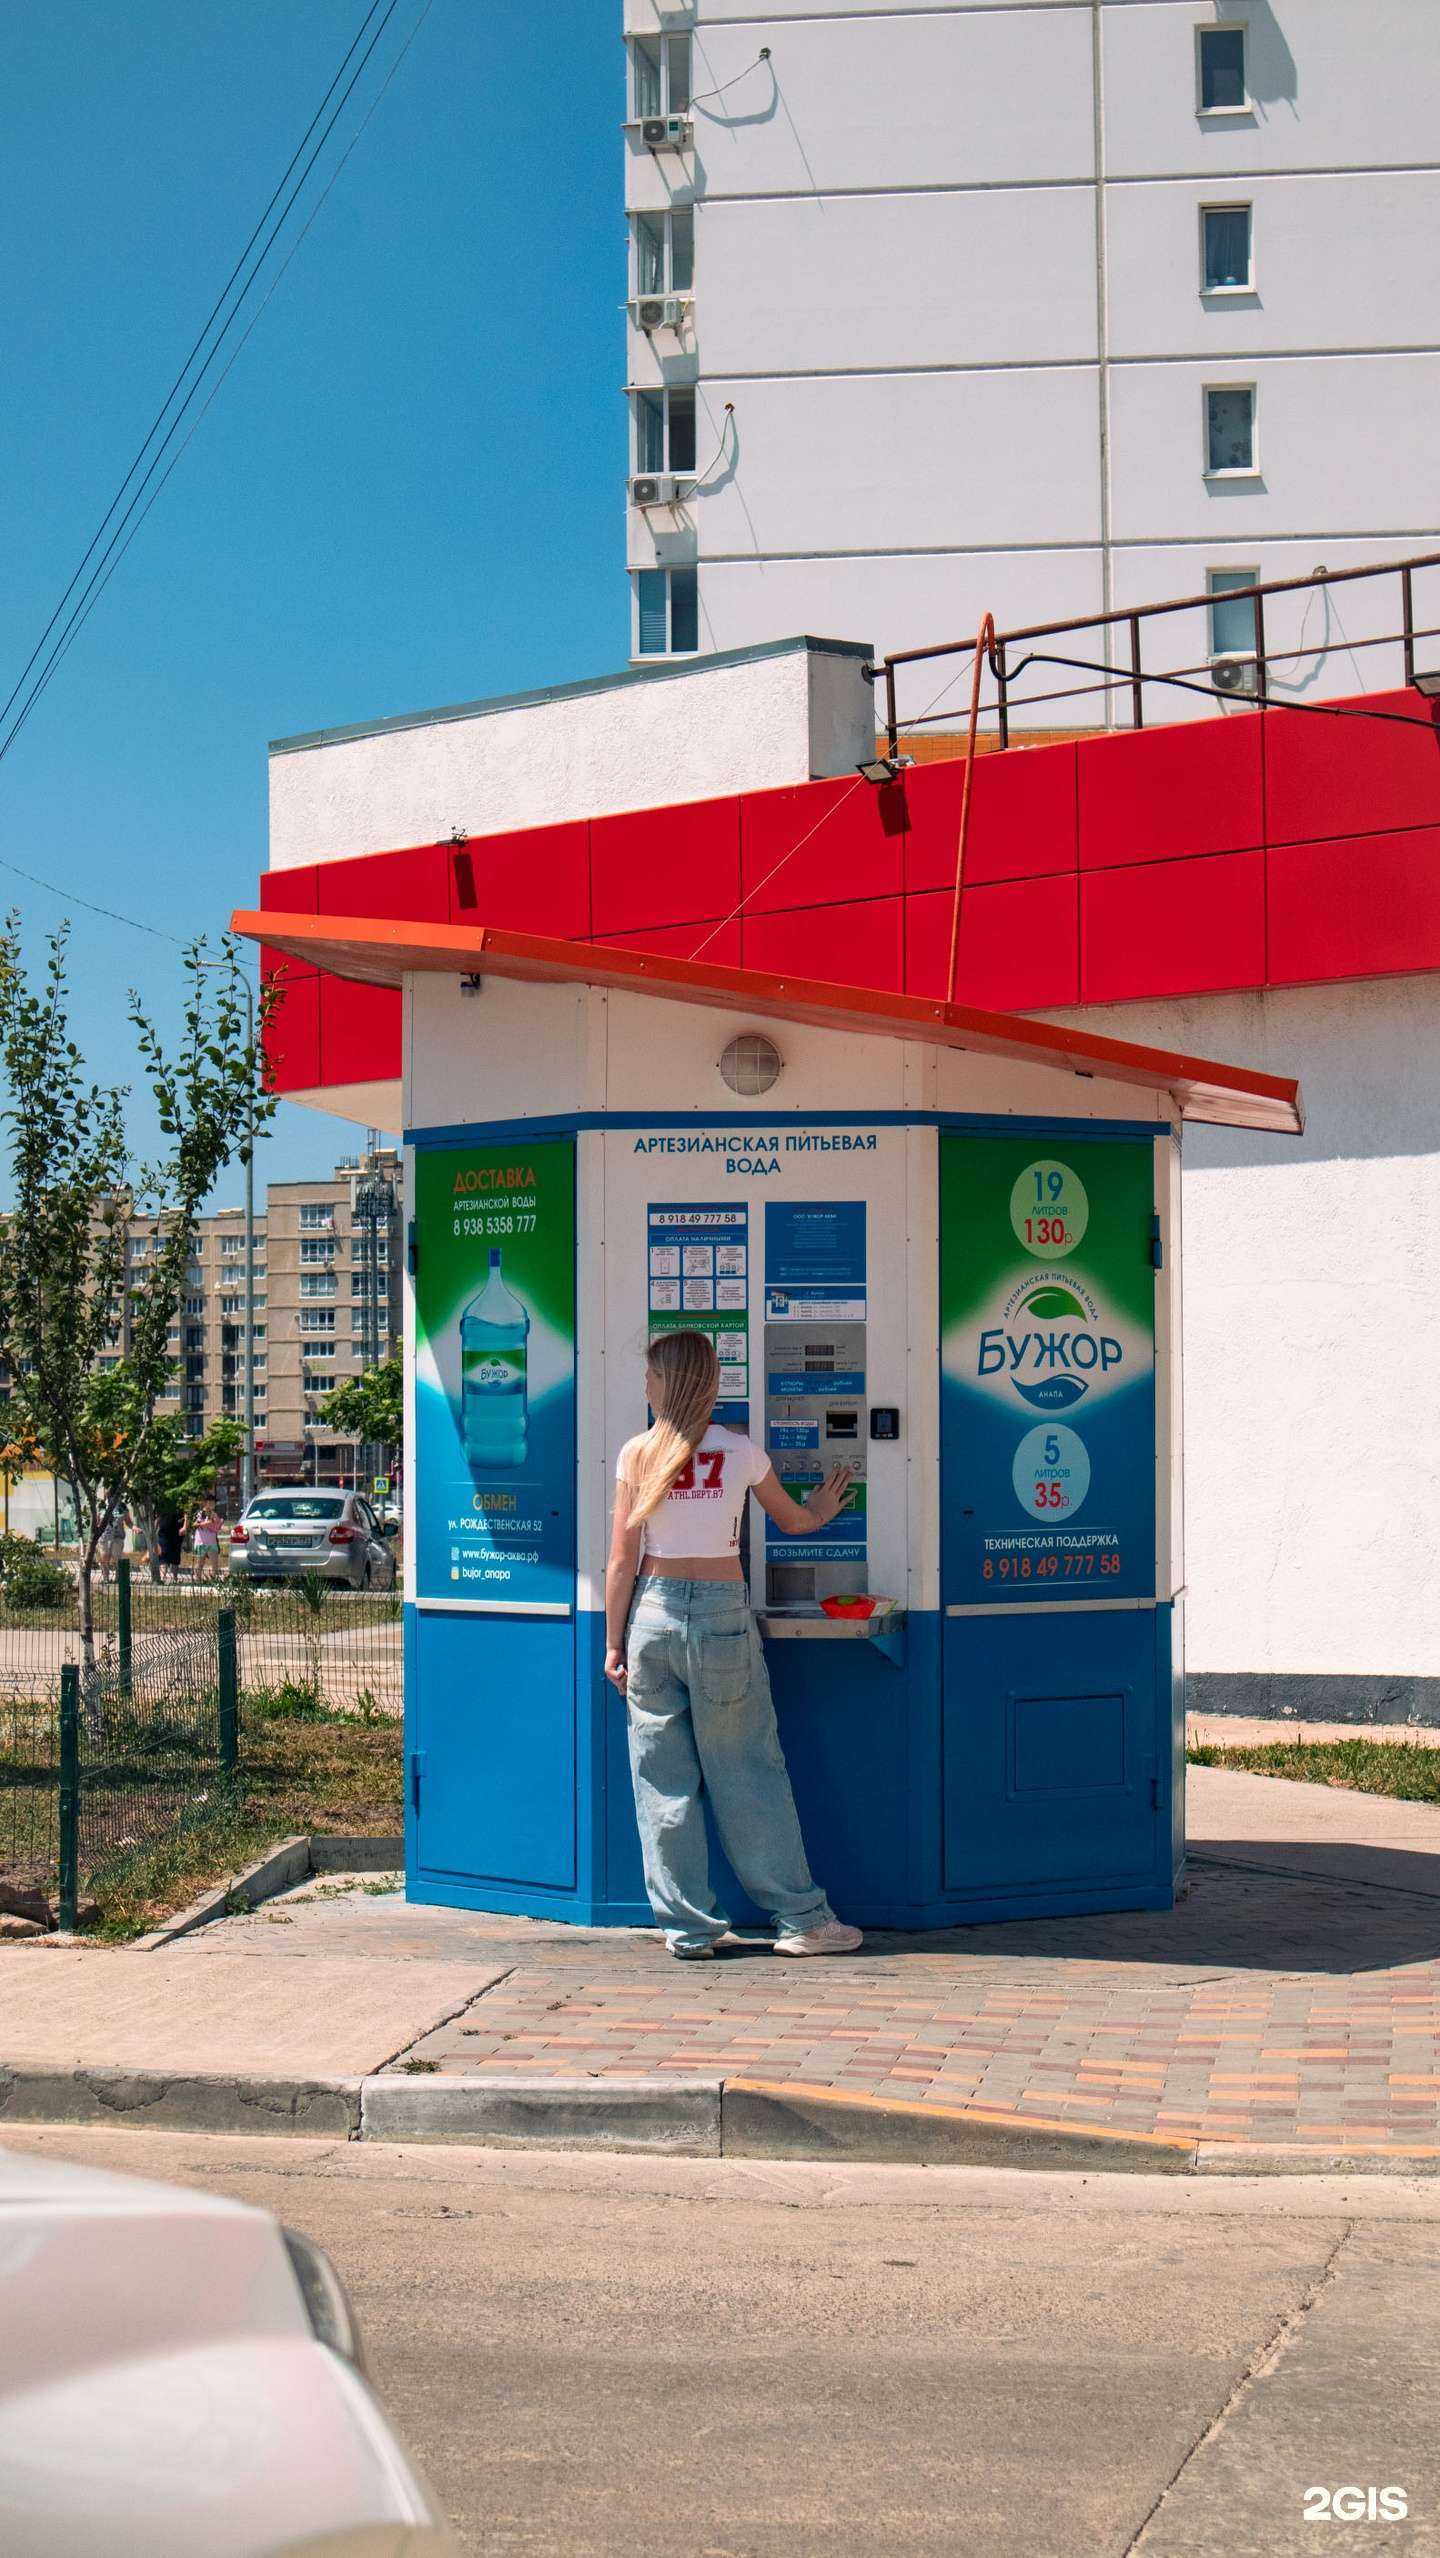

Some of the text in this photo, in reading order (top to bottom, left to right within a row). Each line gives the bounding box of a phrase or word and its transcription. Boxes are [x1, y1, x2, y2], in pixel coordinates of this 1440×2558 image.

[634, 1134, 877, 1153] АРТЕЗИАНСКАЯ ПИТЬЕВАЯ
[726, 1157, 781, 1175] ВОДА
[453, 1167, 537, 1194] ДОСТАВКА
[1033, 1171, 1064, 1201] 19
[453, 1196, 536, 1211] АРТЕЗИАНСКОЙ ВОДЫ
[453, 1214, 536, 1236] 8 938 5358 777
[659, 1214, 736, 1224] 8 918 49 777 58
[1003, 1273, 1099, 1321] АРТЕЗИАНСКАЯ ПИТЬЕВАЯ ВОДА
[1044, 1434, 1060, 1465] 5
[472, 1493, 517, 1511] ОБМЕН
[448, 1518, 542, 1531] ул. РОЖДЕСТВЕНСКАЯ 52
[984, 1534, 1119, 1550] ТЕХНИЧЕСКАЯ ПОДДЕРЖКА
[462, 1547, 539, 1563] www.бужор-аква.рф
[773, 1548, 860, 1558] ВОЗЬМИТЕ СДАЧУ
[462, 1566, 511, 1581] bujor_anapa
[983, 1553, 1121, 1580] 8 918 49 777 58
